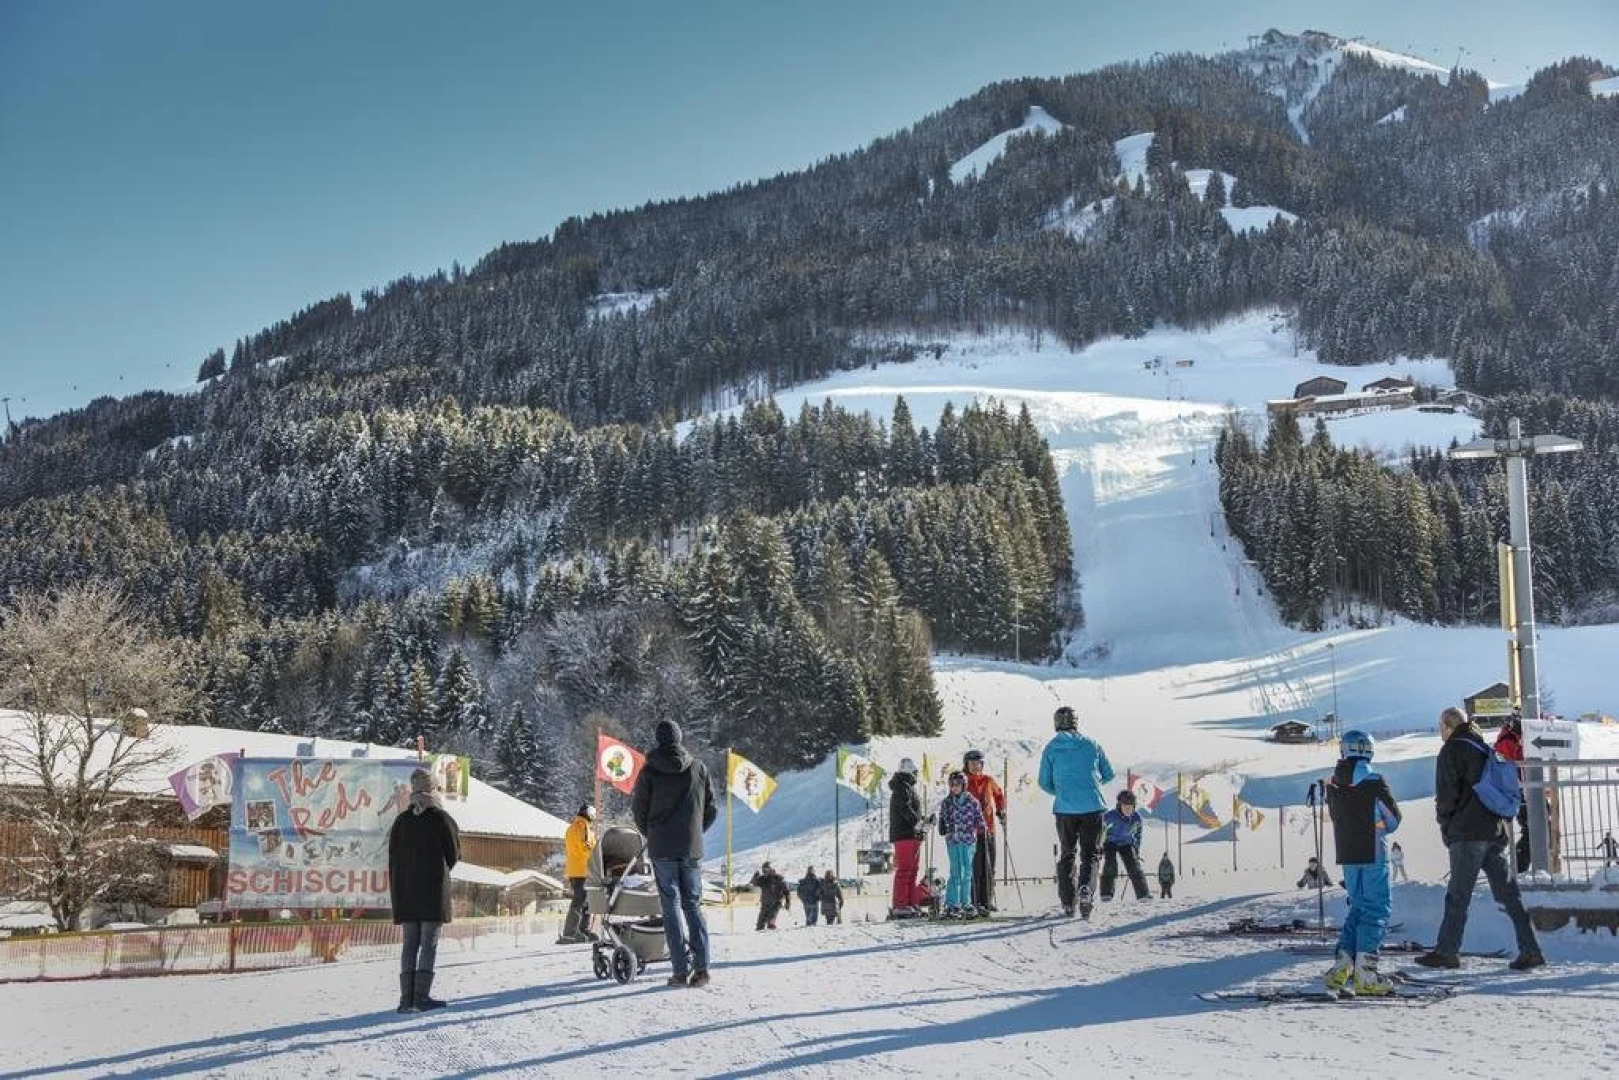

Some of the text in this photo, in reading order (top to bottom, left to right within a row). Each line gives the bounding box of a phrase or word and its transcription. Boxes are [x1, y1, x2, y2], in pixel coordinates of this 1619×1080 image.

[266, 757, 338, 808] The
[287, 781, 373, 836] Reds
[227, 868, 389, 895] SCHISCHU
